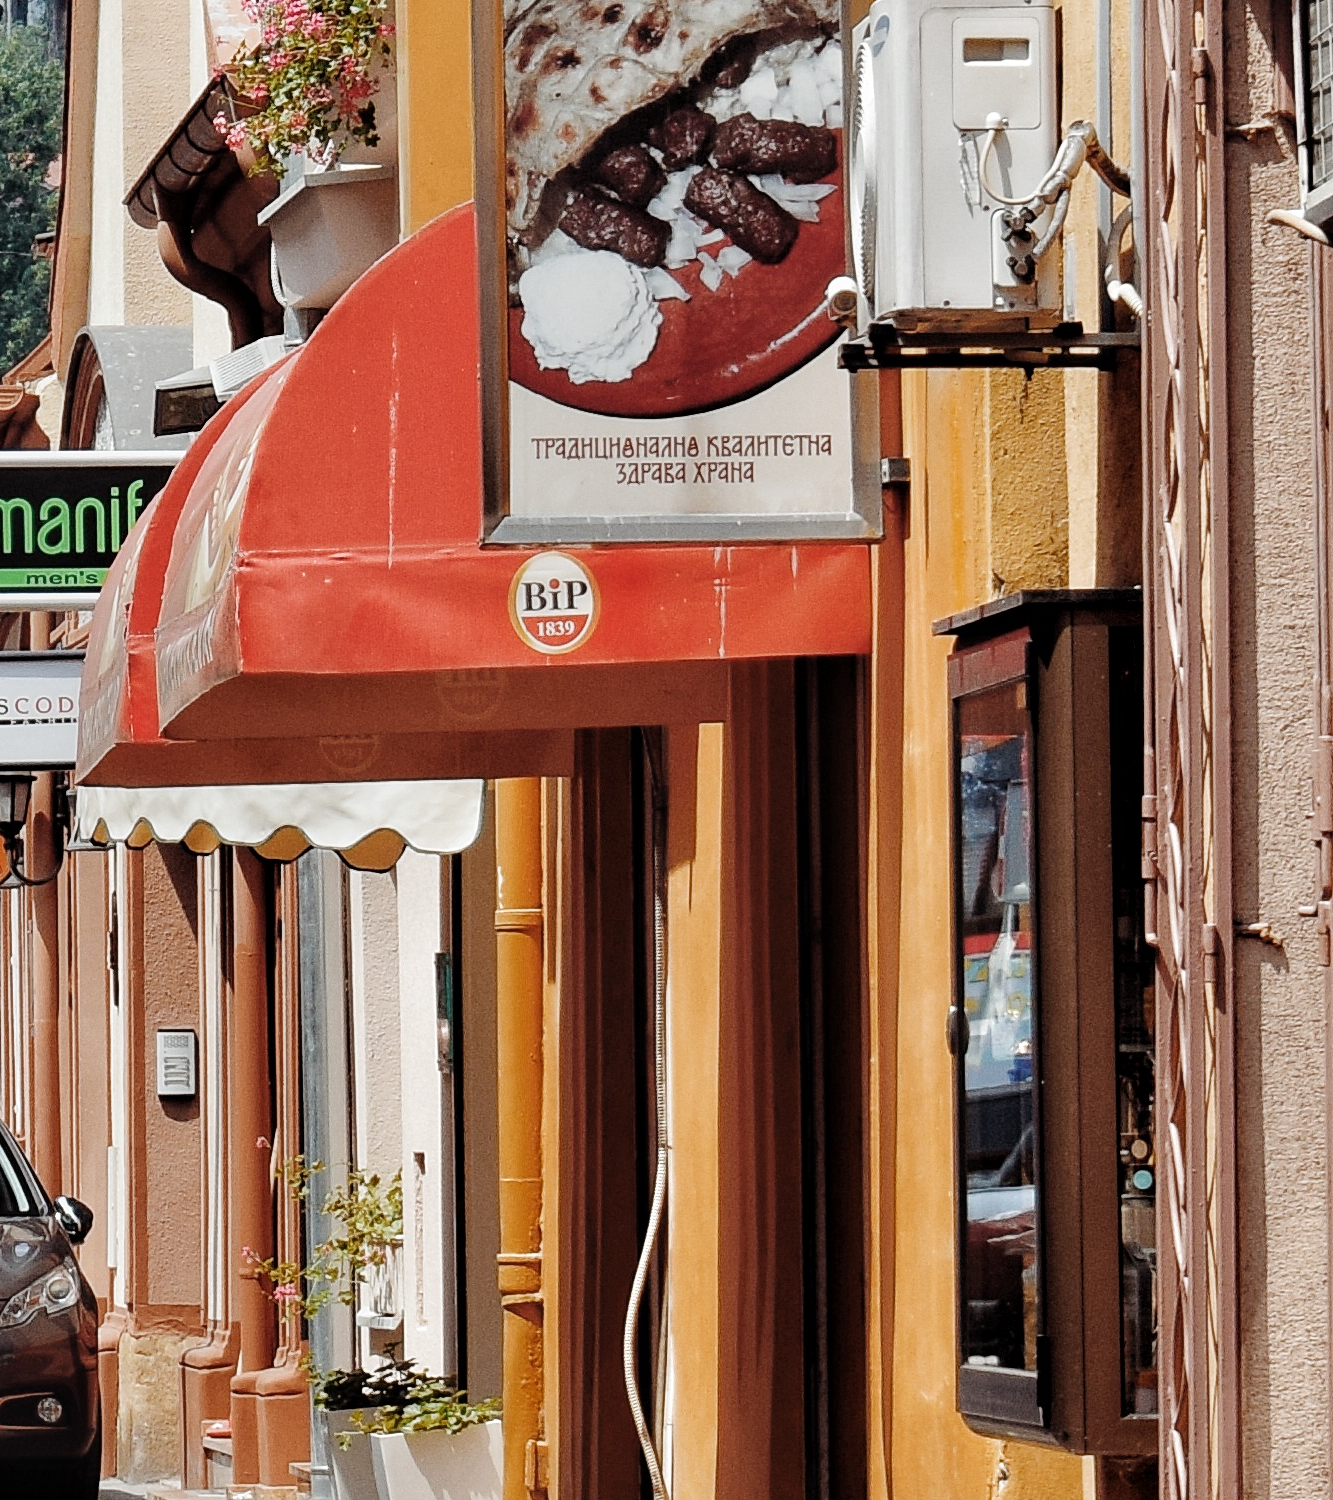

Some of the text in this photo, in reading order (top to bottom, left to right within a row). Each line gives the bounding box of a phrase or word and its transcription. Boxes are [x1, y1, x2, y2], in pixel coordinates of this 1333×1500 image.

[707, 434, 833, 458] КВАЛИТЕТНА
[616, 461, 755, 485] ЗДРАВА ХРАНА
[26, 571, 98, 585] men's
[536, 620, 575, 637] 1839
